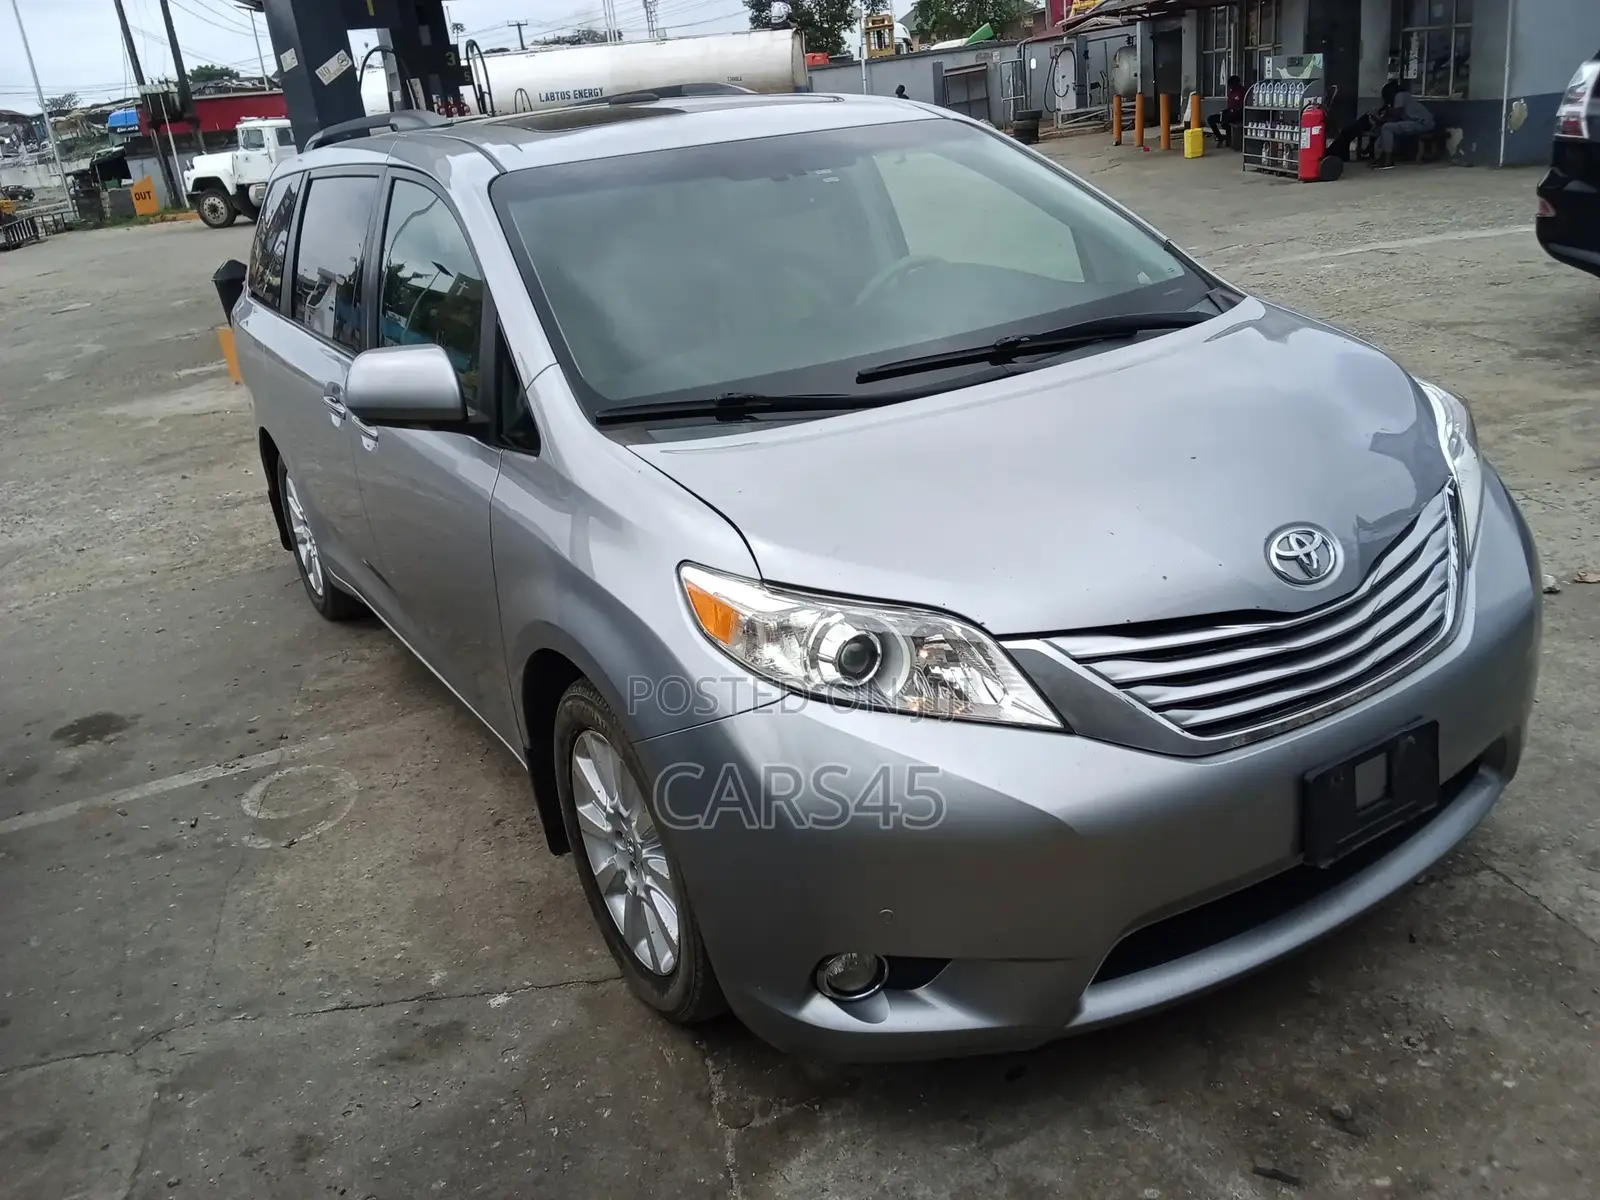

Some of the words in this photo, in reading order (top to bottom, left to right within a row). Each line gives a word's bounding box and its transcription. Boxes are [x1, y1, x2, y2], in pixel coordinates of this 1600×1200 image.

[445, 51, 456, 66] 3
[463, 71, 471, 82] 5
[538, 90, 571, 103] LABTOS
[573, 86, 604, 100] ENERGY
[134, 190, 152, 201] OUT
